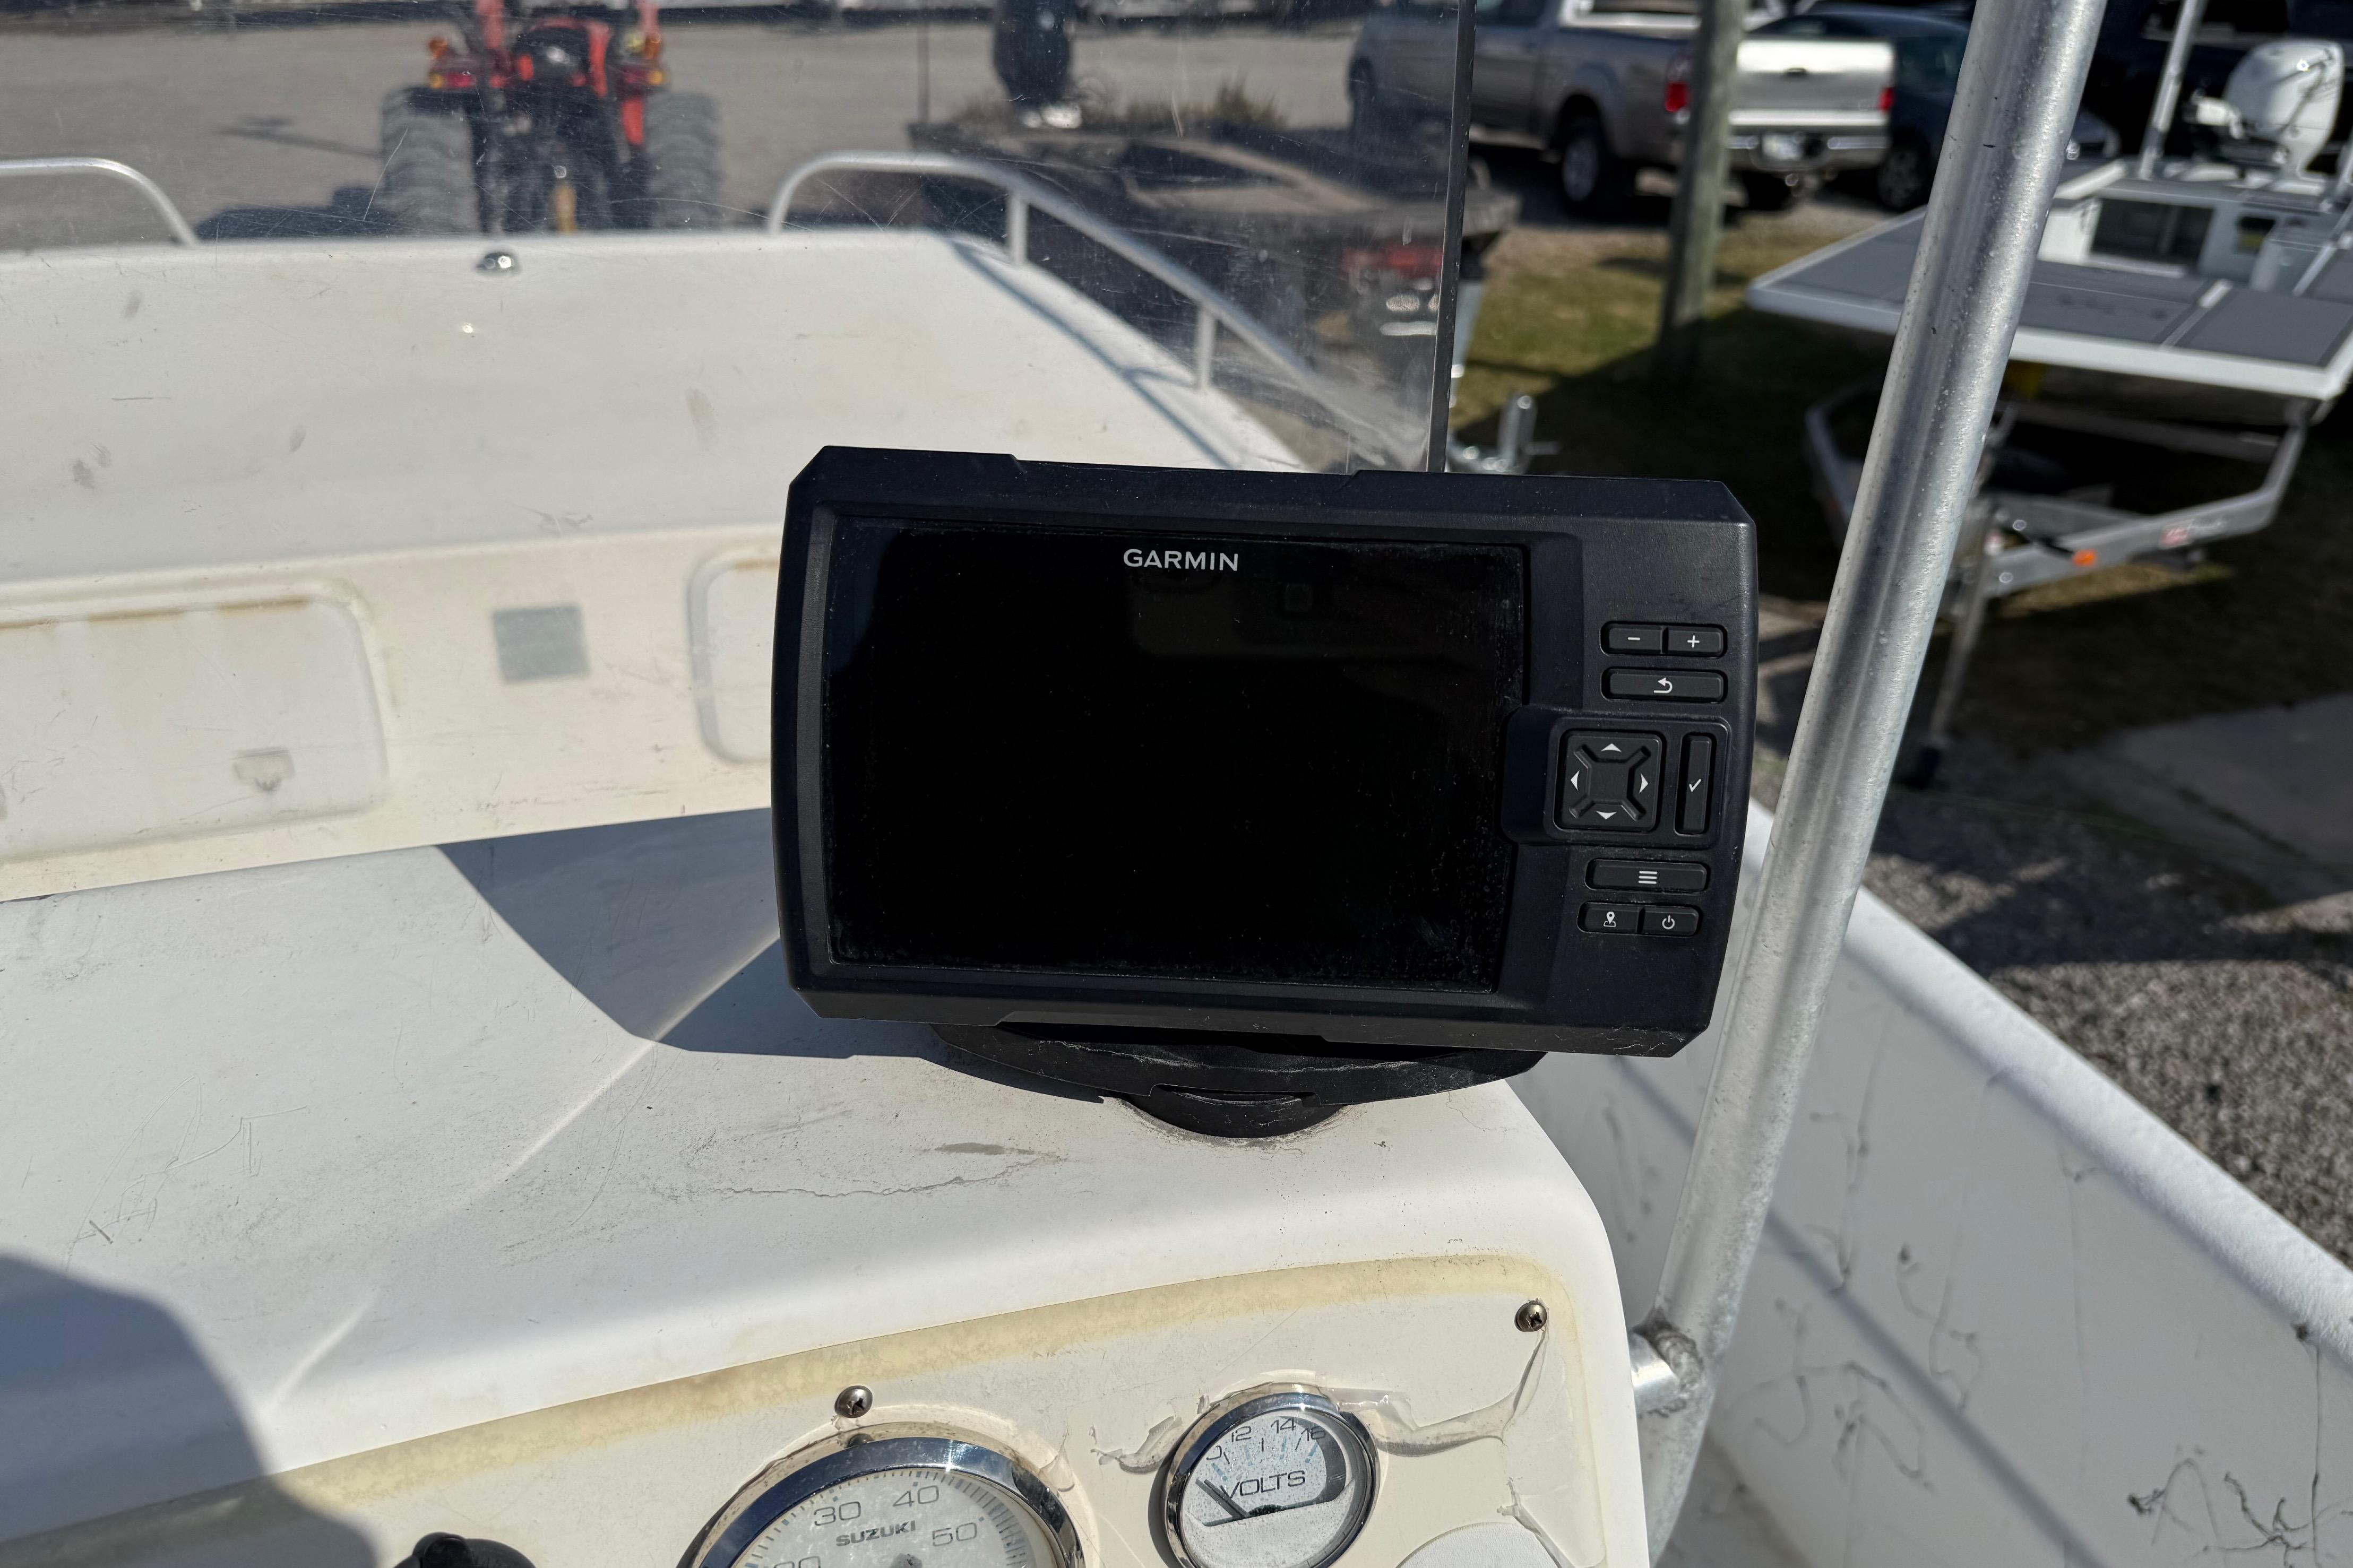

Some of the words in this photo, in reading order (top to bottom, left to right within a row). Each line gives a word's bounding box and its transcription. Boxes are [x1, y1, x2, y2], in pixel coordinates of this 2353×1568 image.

[1123, 548, 1239, 571] GARMIN
[1231, 1425, 1252, 1442] 12
[1270, 1417, 1296, 1434] 14
[1300, 1425, 1326, 1442] 16
[1220, 1470, 1306, 1498] VOLTS
[892, 1485, 940, 1508] 40
[813, 1501, 861, 1526] 30
[835, 1520, 916, 1547] SUZUKI
[932, 1522, 977, 1547] 50
